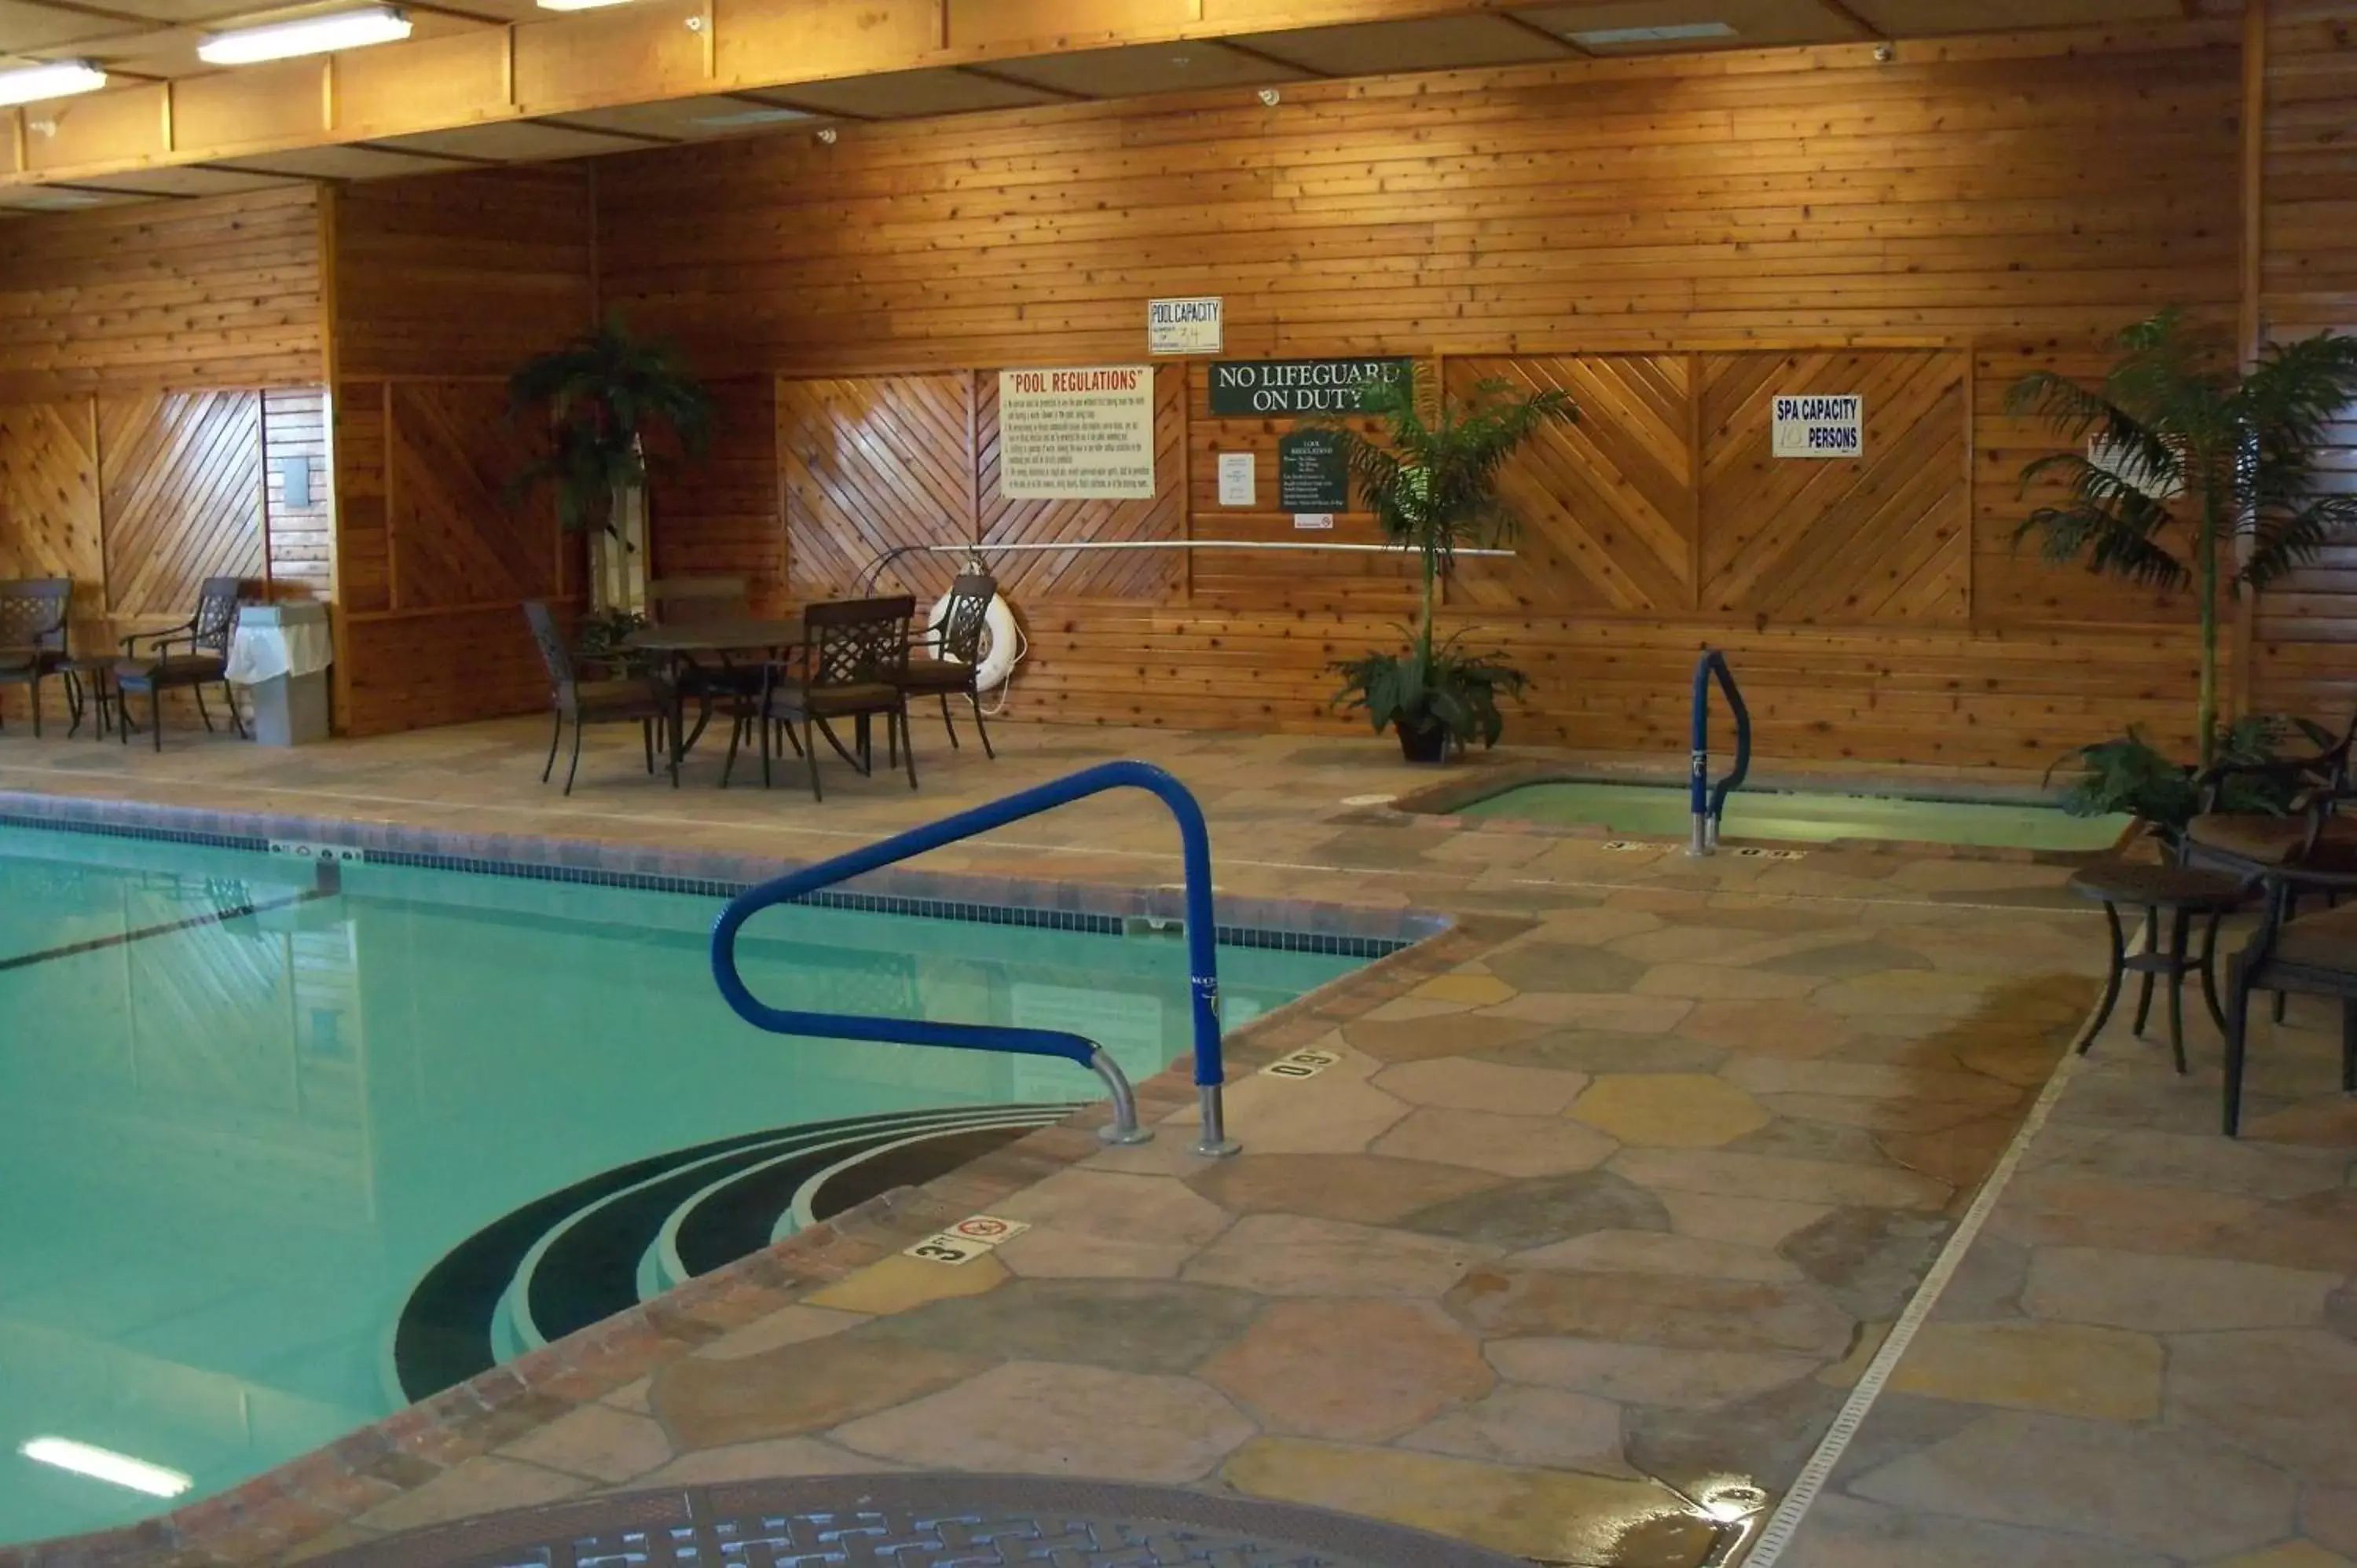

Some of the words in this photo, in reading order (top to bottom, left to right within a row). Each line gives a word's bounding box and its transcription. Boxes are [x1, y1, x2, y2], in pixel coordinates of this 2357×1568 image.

[1153, 305, 1174, 323] POOL
[1175, 302, 1218, 322] CAPACITY
[1219, 367, 1255, 387] NO
[1262, 363, 1400, 386] LIFEGUARD
[1253, 390, 1288, 411] ON
[1296, 389, 1361, 409] DUTY
[1777, 400, 1798, 420] SPA
[1802, 398, 1857, 419] CAPACITY
[1809, 427, 1857, 448] PERSONS
[916, 1246, 966, 1260] 3
